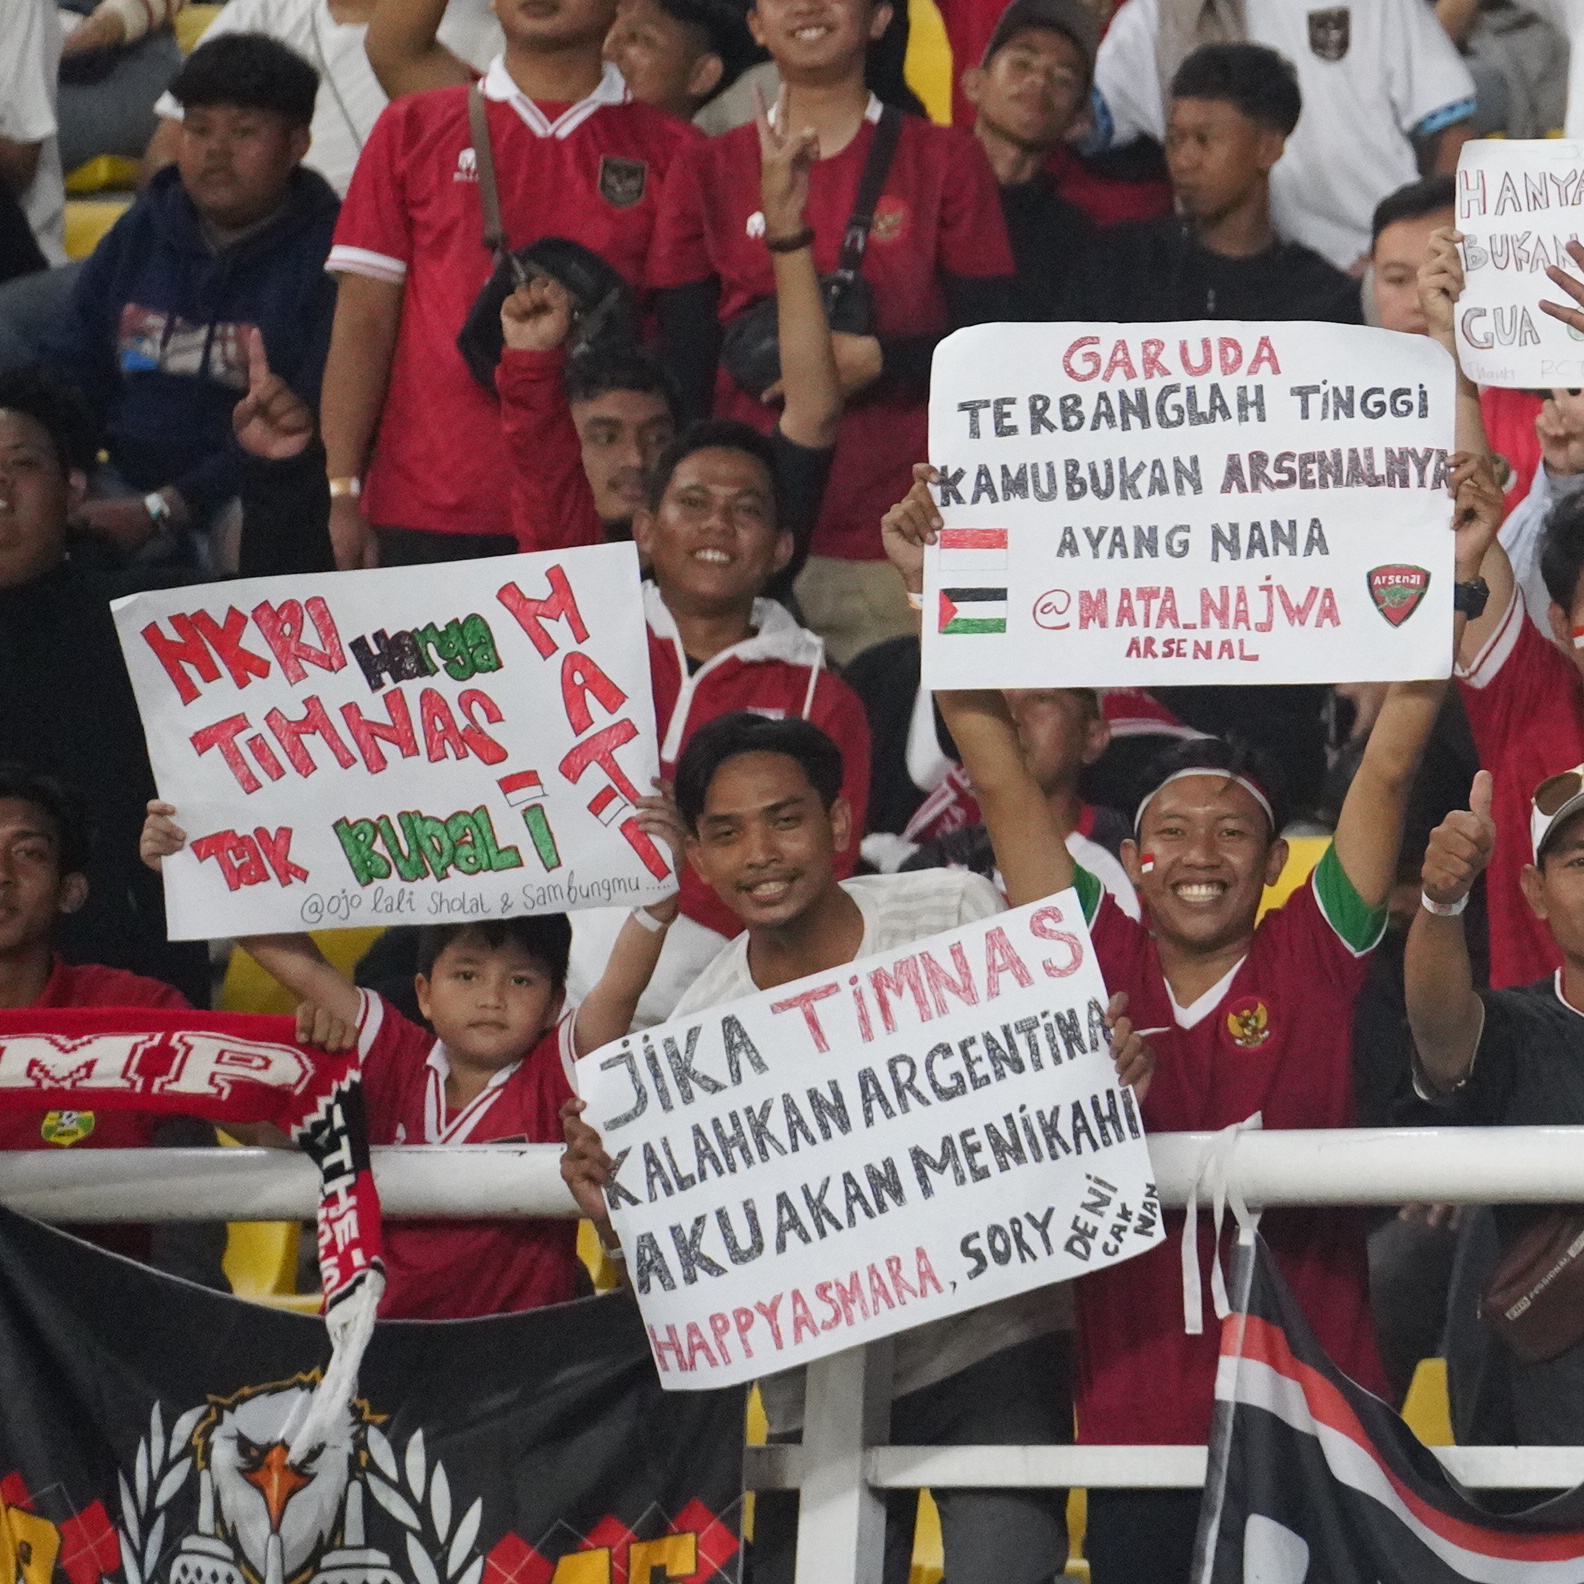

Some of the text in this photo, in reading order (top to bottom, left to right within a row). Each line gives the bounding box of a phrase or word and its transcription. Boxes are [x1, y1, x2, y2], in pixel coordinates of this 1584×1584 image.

[1462, 229, 1580, 273] BUKAN
[1461, 303, 1541, 350] GUA
[1062, 334, 1282, 383] GARUDA
[956, 381, 1267, 440] TERBANGLAH
[937, 445, 1454, 508] KAMUBUKAN ARSENALNYA
[1055, 516, 1331, 565] AYANG NANA
[140, 595, 350, 707] NKRI
[1124, 635, 1260, 663] ARSENAL
[1131, 1181, 1160, 1240] NAN
[958, 1204, 1060, 1282] SORY
